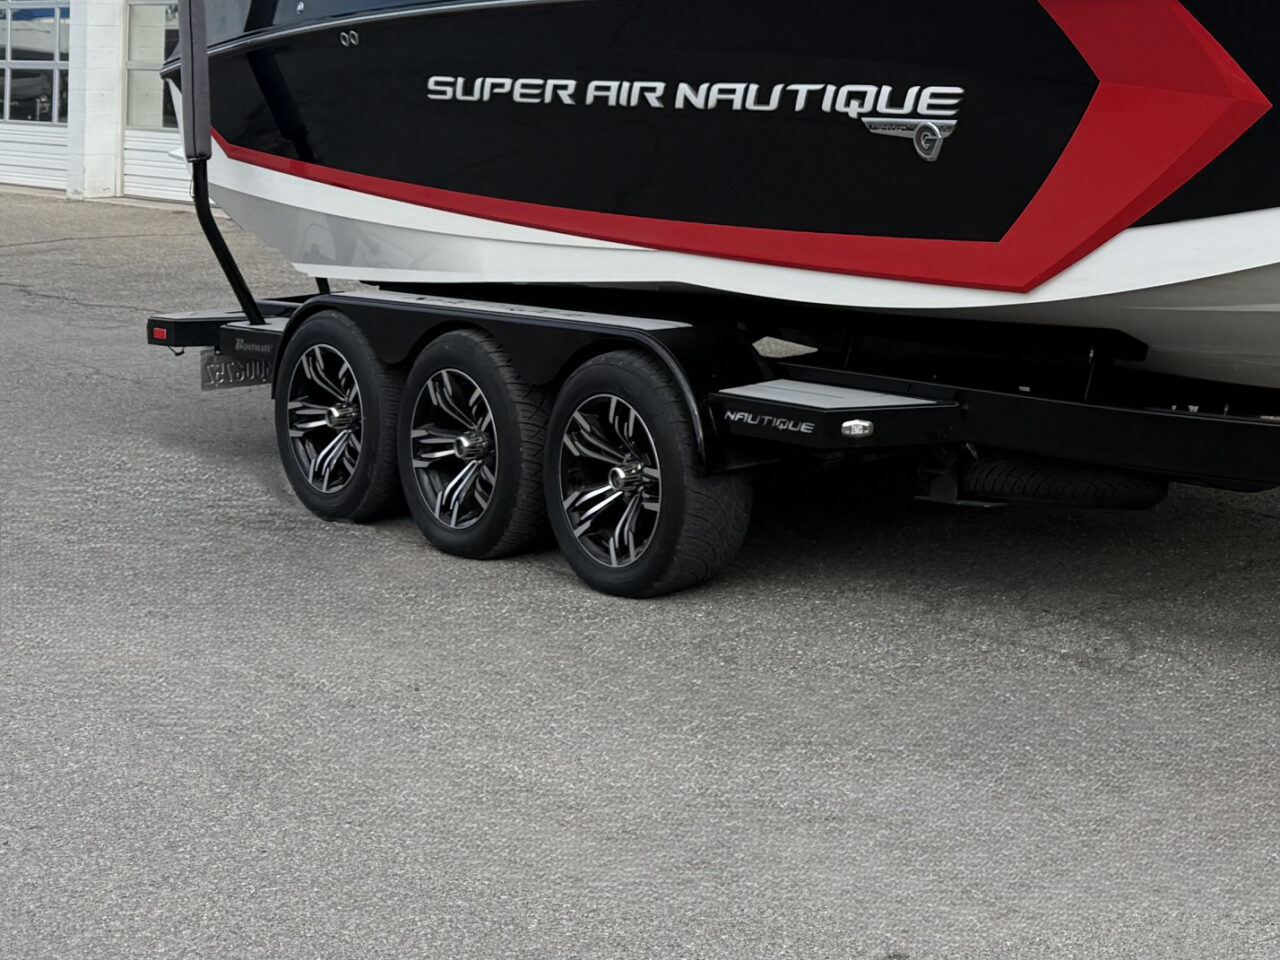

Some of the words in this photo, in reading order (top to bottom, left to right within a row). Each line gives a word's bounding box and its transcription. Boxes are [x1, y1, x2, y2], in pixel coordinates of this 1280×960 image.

[427, 75, 578, 105] SUPER
[586, 80, 667, 108] AIR
[674, 82, 965, 119] NAUTIQUE
[724, 410, 816, 435] NAUTIQUE
